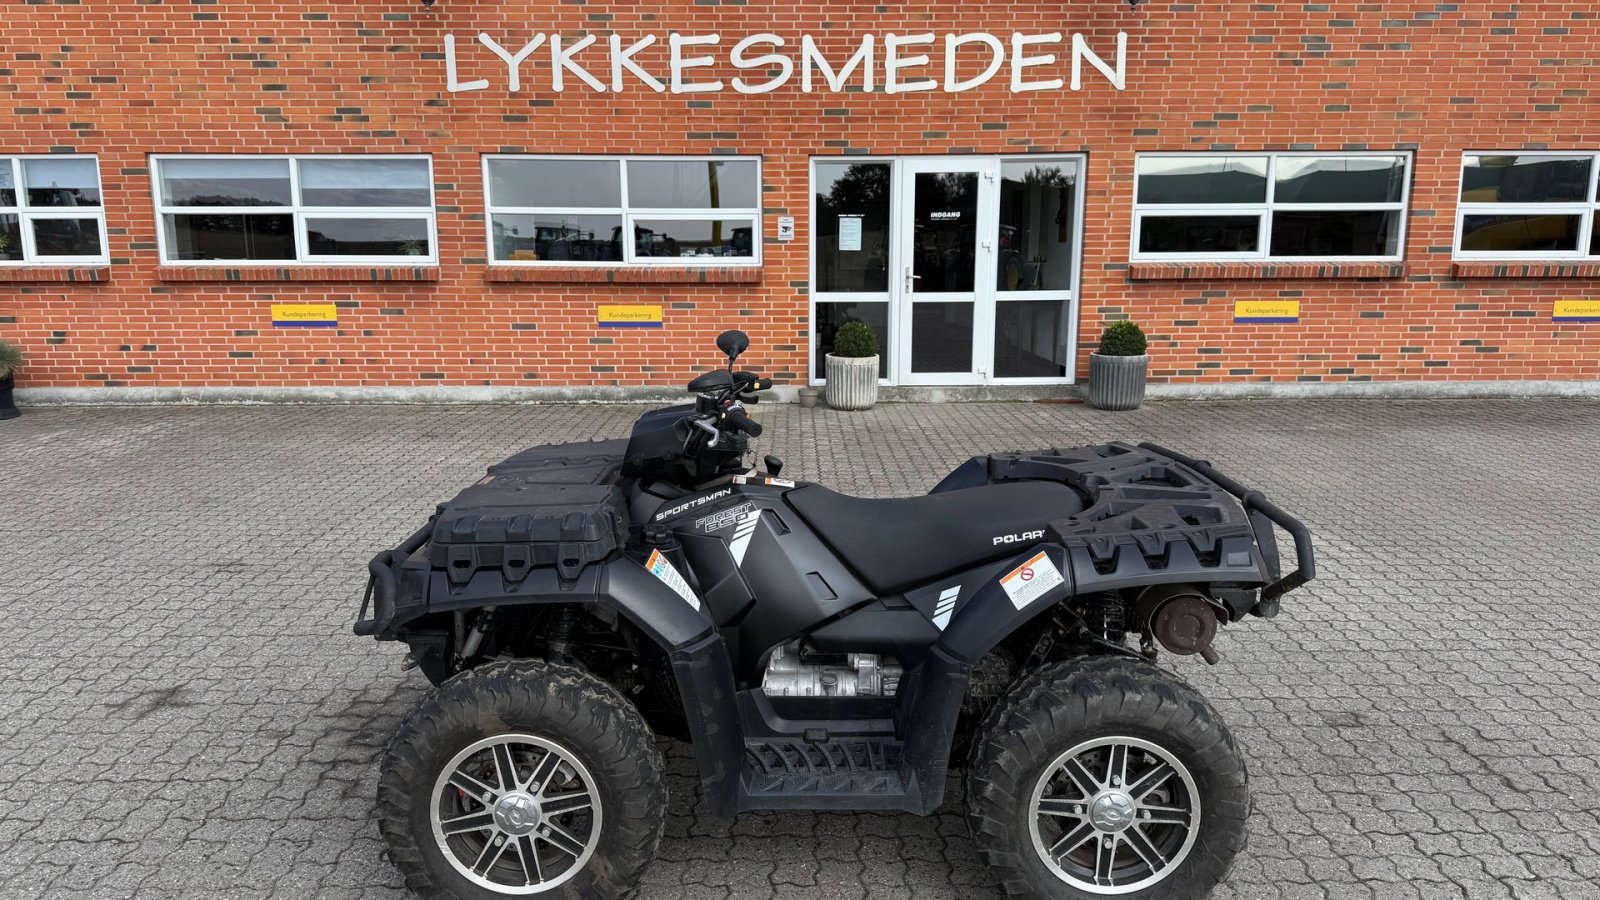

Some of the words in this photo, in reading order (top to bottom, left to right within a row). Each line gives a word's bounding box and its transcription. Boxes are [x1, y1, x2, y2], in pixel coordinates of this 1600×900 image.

[444, 32, 1128, 95] LYKKESMEDEN
[282, 311, 327, 319] Kundeparkering
[1245, 307, 1289, 315] Kundeparkering
[656, 488, 731, 522] SPORTSMAN
[696, 502, 751, 528] FOREST
[705, 512, 749, 533] 850
